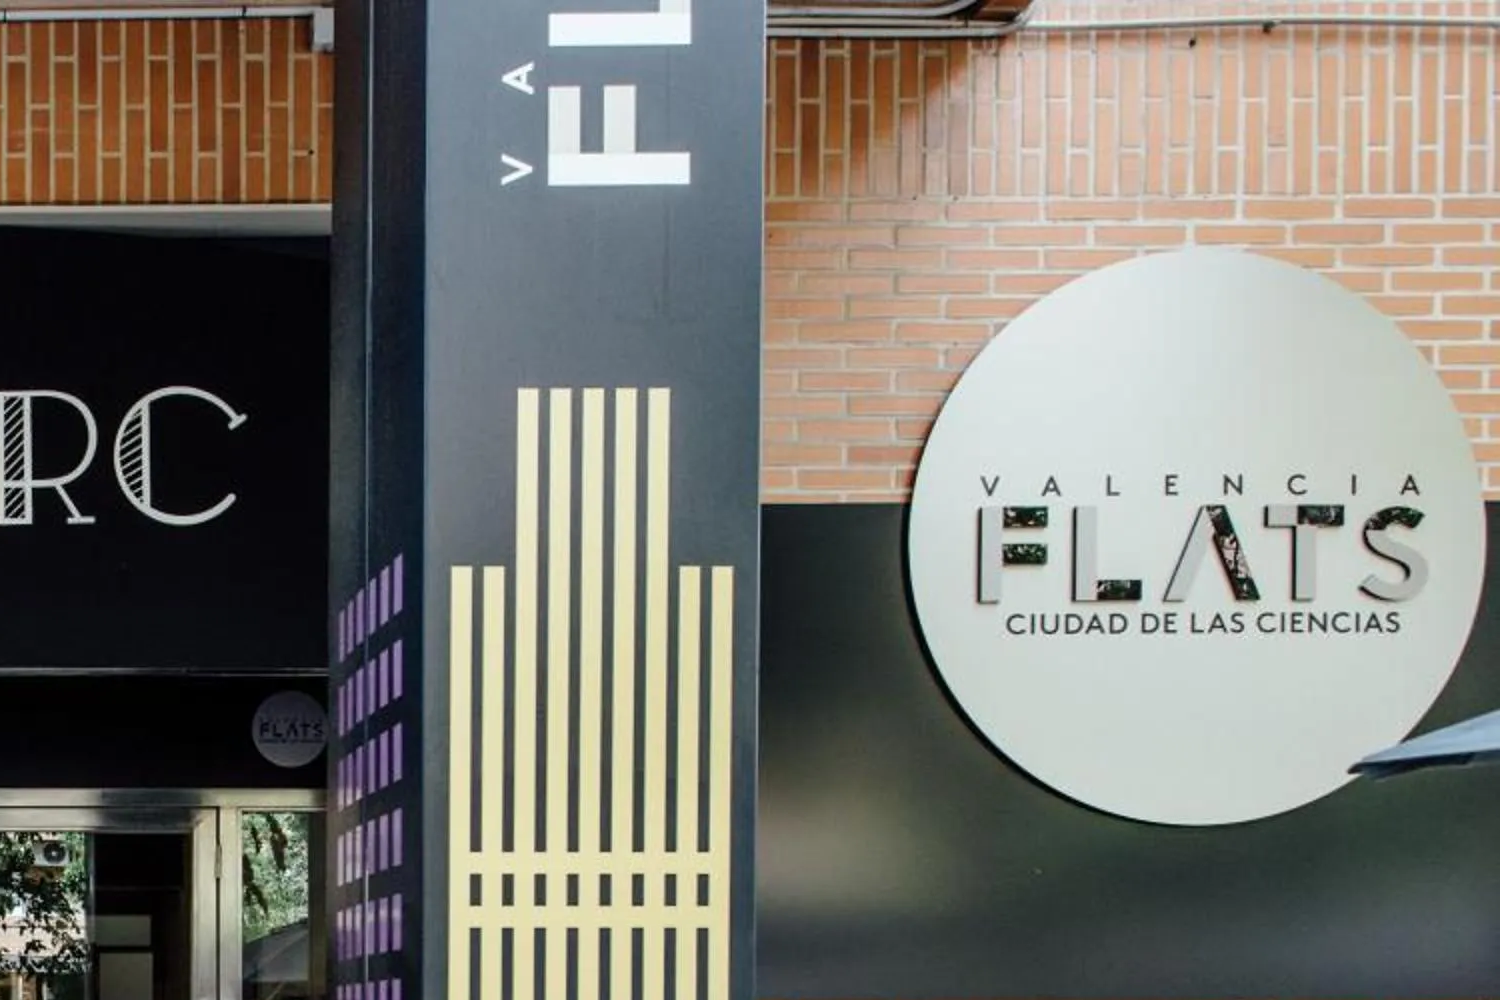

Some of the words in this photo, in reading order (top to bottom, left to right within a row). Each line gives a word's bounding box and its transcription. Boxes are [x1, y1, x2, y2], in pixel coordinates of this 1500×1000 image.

[979, 473, 1421, 497] VALENCIA
[976, 504, 1429, 604] FLATS
[1005, 613, 1129, 636] CIUDAD
[1140, 613, 1178, 635] DE
[1189, 612, 1246, 635] LAS
[1256, 612, 1402, 634] CIENCIAS
[259, 722, 324, 737] FLATS
